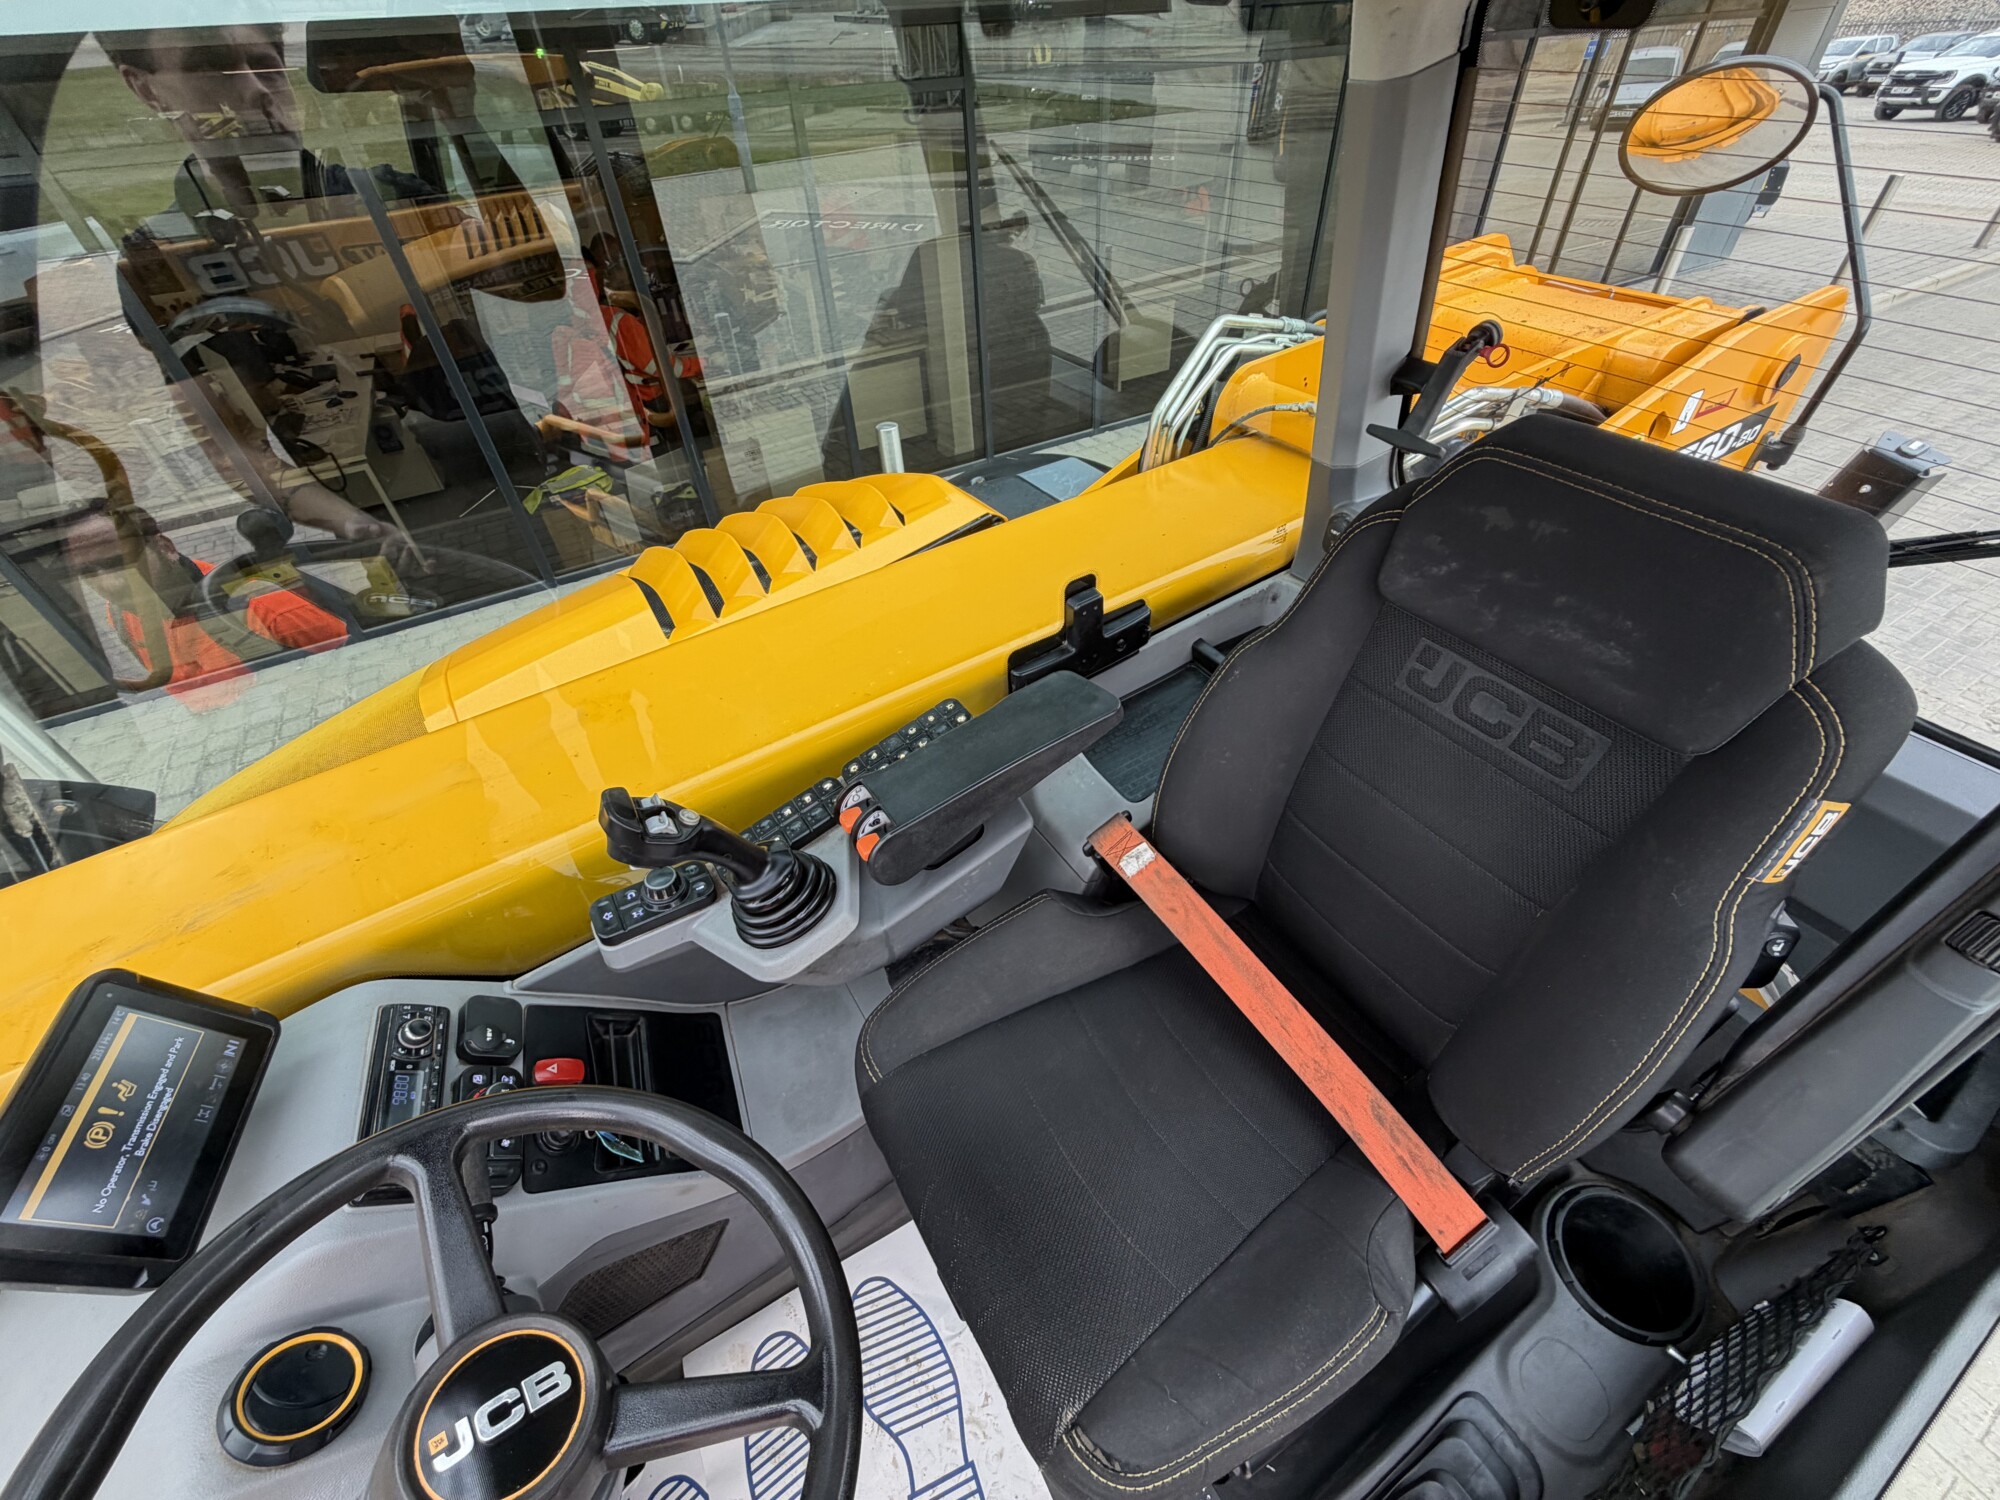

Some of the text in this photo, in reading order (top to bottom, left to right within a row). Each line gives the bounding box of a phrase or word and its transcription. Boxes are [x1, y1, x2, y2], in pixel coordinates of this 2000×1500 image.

[1404, 642, 1598, 781] JCB
[1780, 811, 1840, 878] JCB
[164, 1052, 176, 1070] and
[169, 1036, 185, 1054] Park
[147, 1068, 170, 1100] Engaged
[121, 1100, 153, 1152] Transmission
[134, 1088, 174, 1157] Brake Disengaged
[92, 1198, 107, 1214] No
[431, 1360, 573, 1473] JCB
